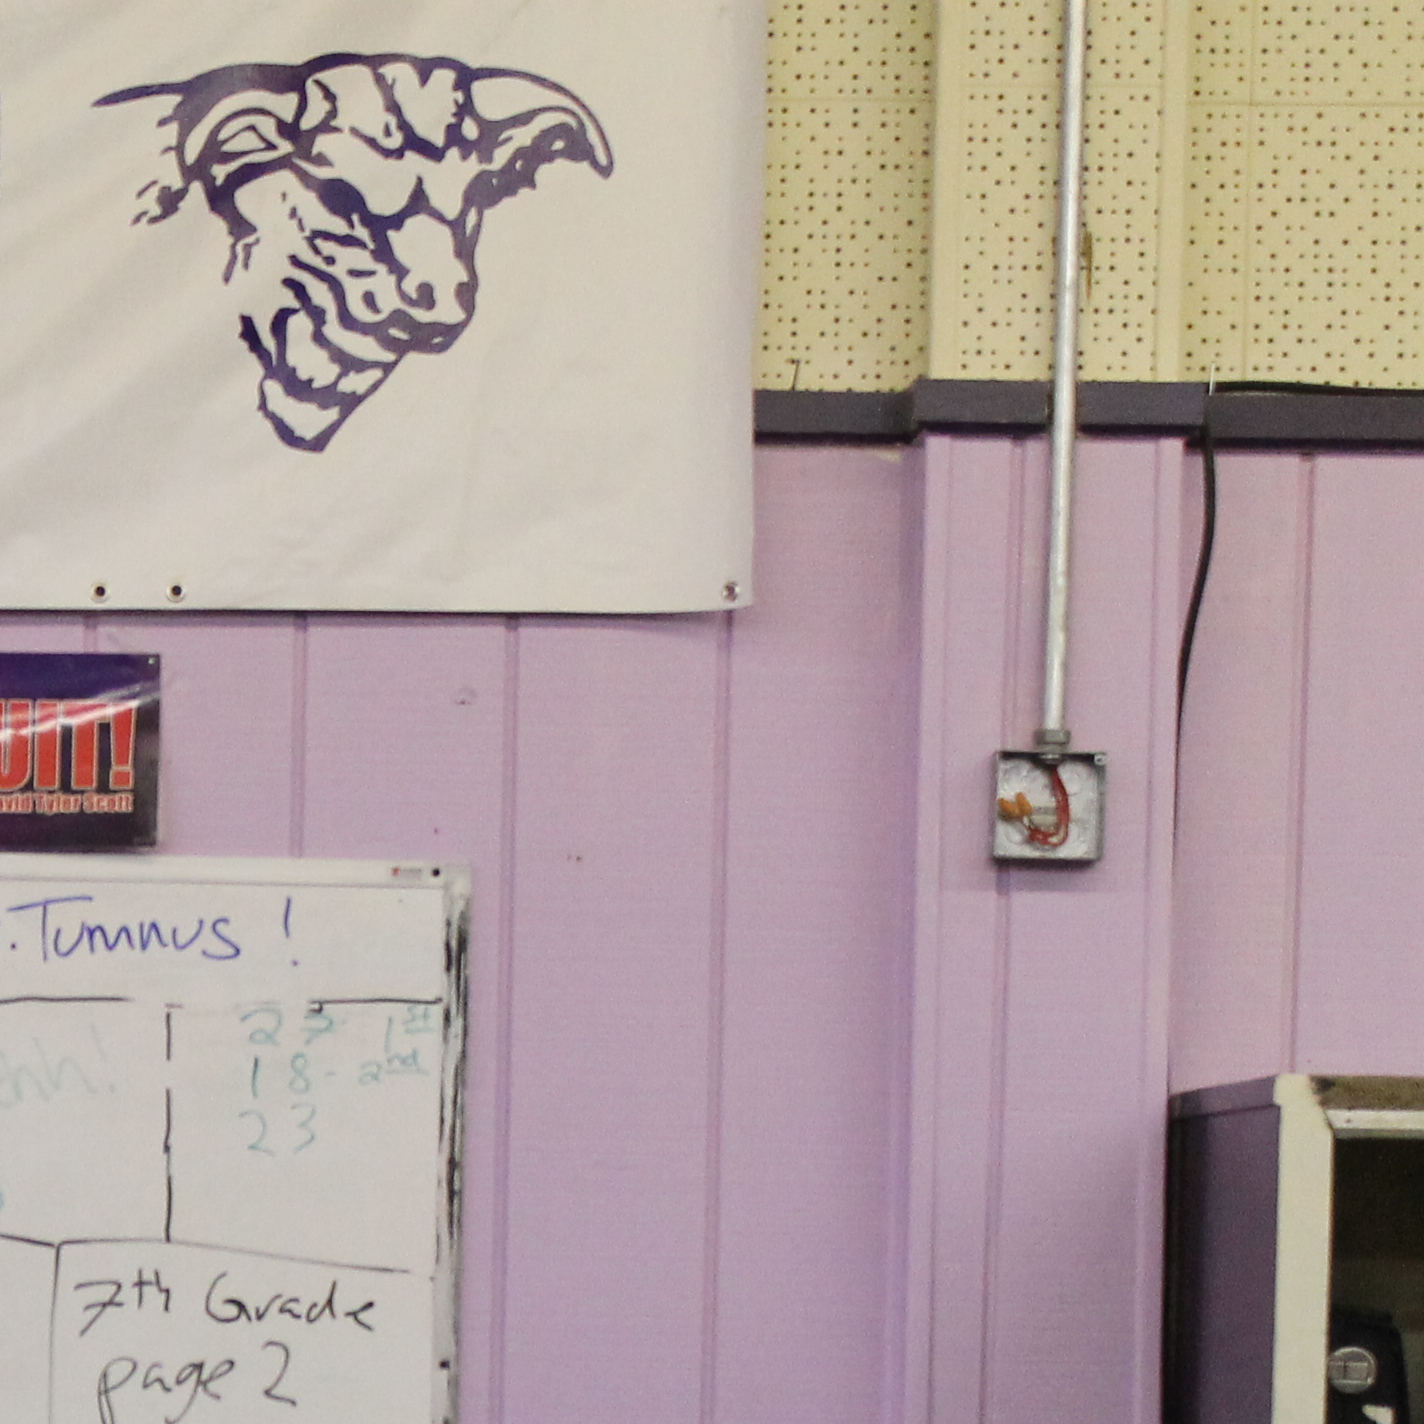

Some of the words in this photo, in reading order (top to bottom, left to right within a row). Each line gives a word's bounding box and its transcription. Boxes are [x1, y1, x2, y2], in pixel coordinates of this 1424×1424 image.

[73, 1268, 171, 1337] 7th
[205, 1271, 376, 1332] Grade
[262, 1341, 297, 1407] 2
